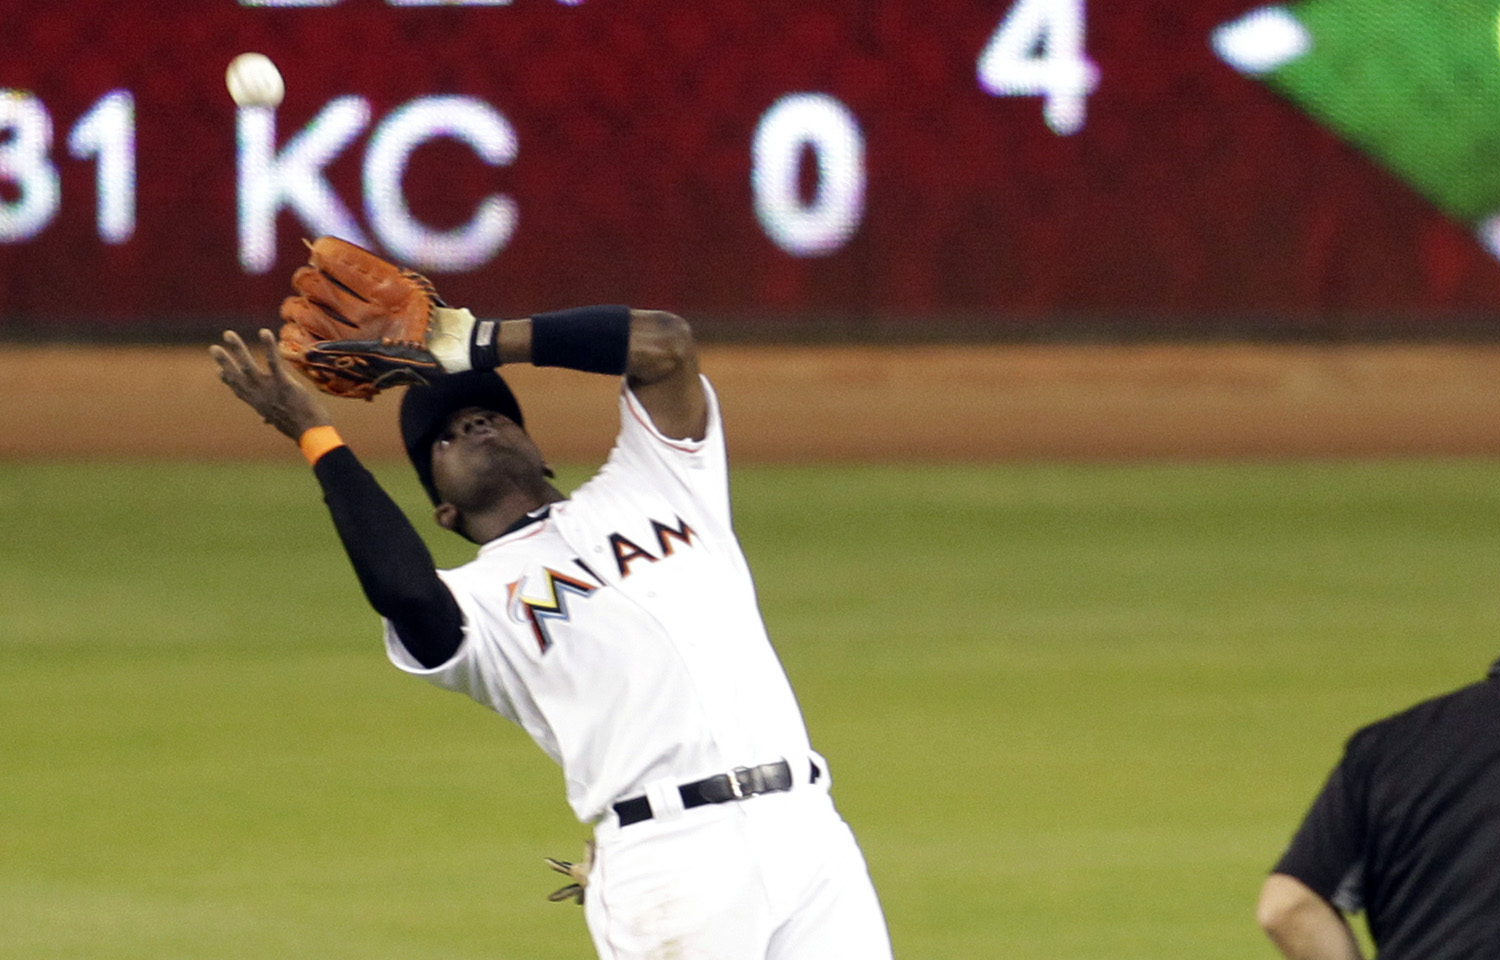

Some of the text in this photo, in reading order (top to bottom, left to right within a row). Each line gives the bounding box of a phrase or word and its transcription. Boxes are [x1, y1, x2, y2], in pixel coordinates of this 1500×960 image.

[976, 0, 1099, 135] 4
[235, 94, 519, 273] KC
[751, 92, 865, 257] 0
